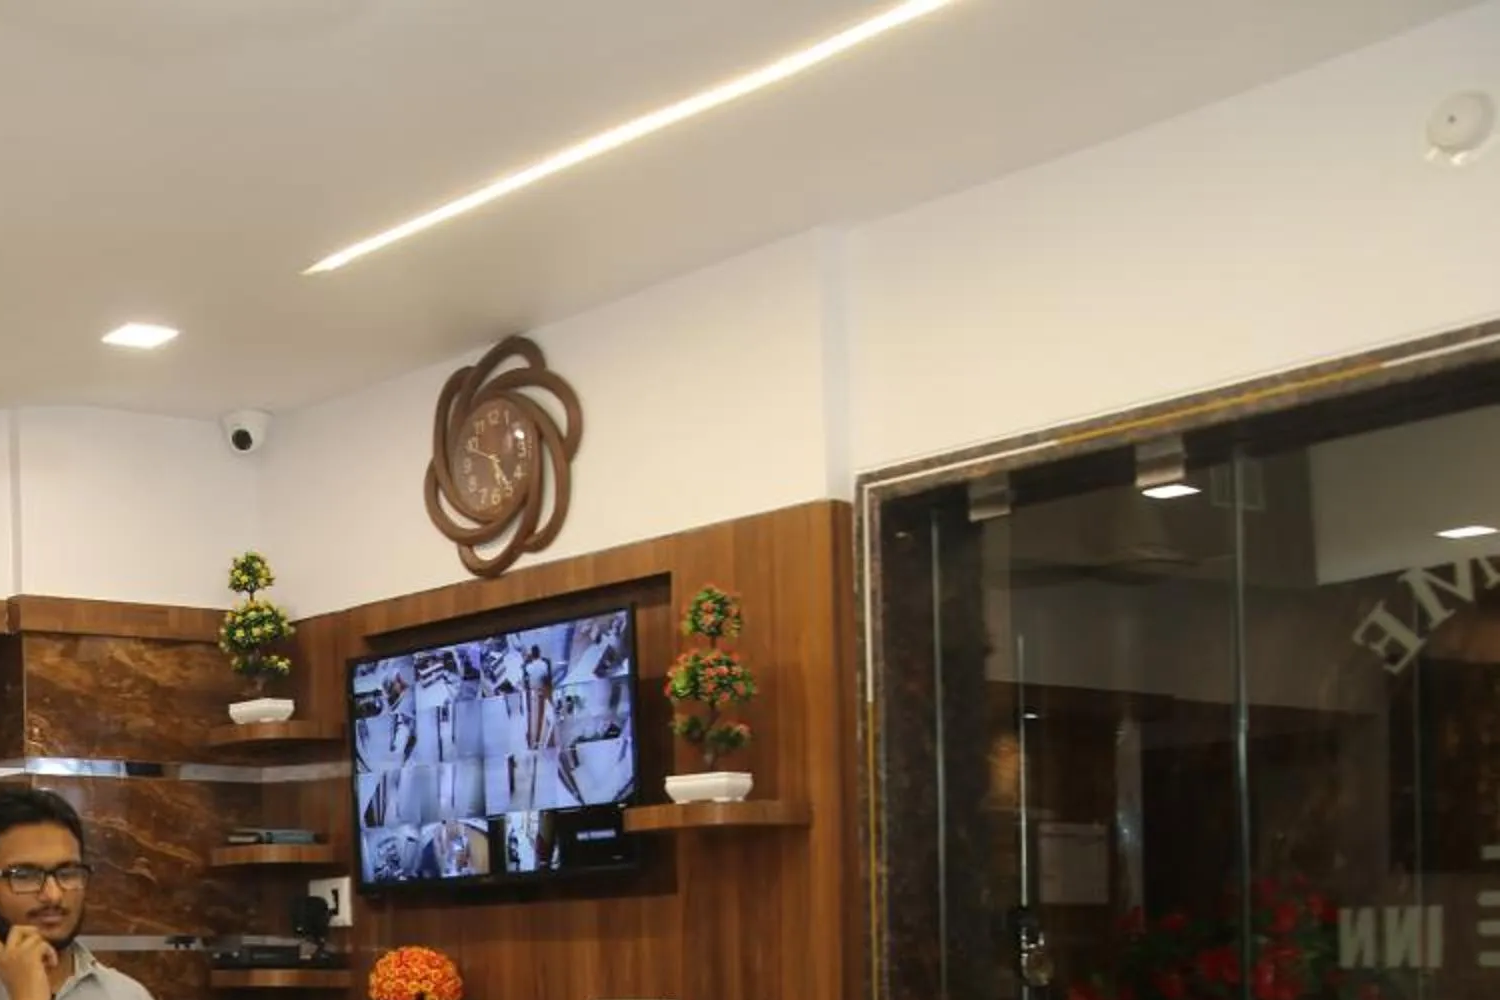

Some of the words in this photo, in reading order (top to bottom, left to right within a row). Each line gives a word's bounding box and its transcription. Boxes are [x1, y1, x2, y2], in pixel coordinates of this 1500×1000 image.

[517, 441, 527, 458] 3
[478, 488, 488, 505] 7
[491, 488, 502, 506] 6
